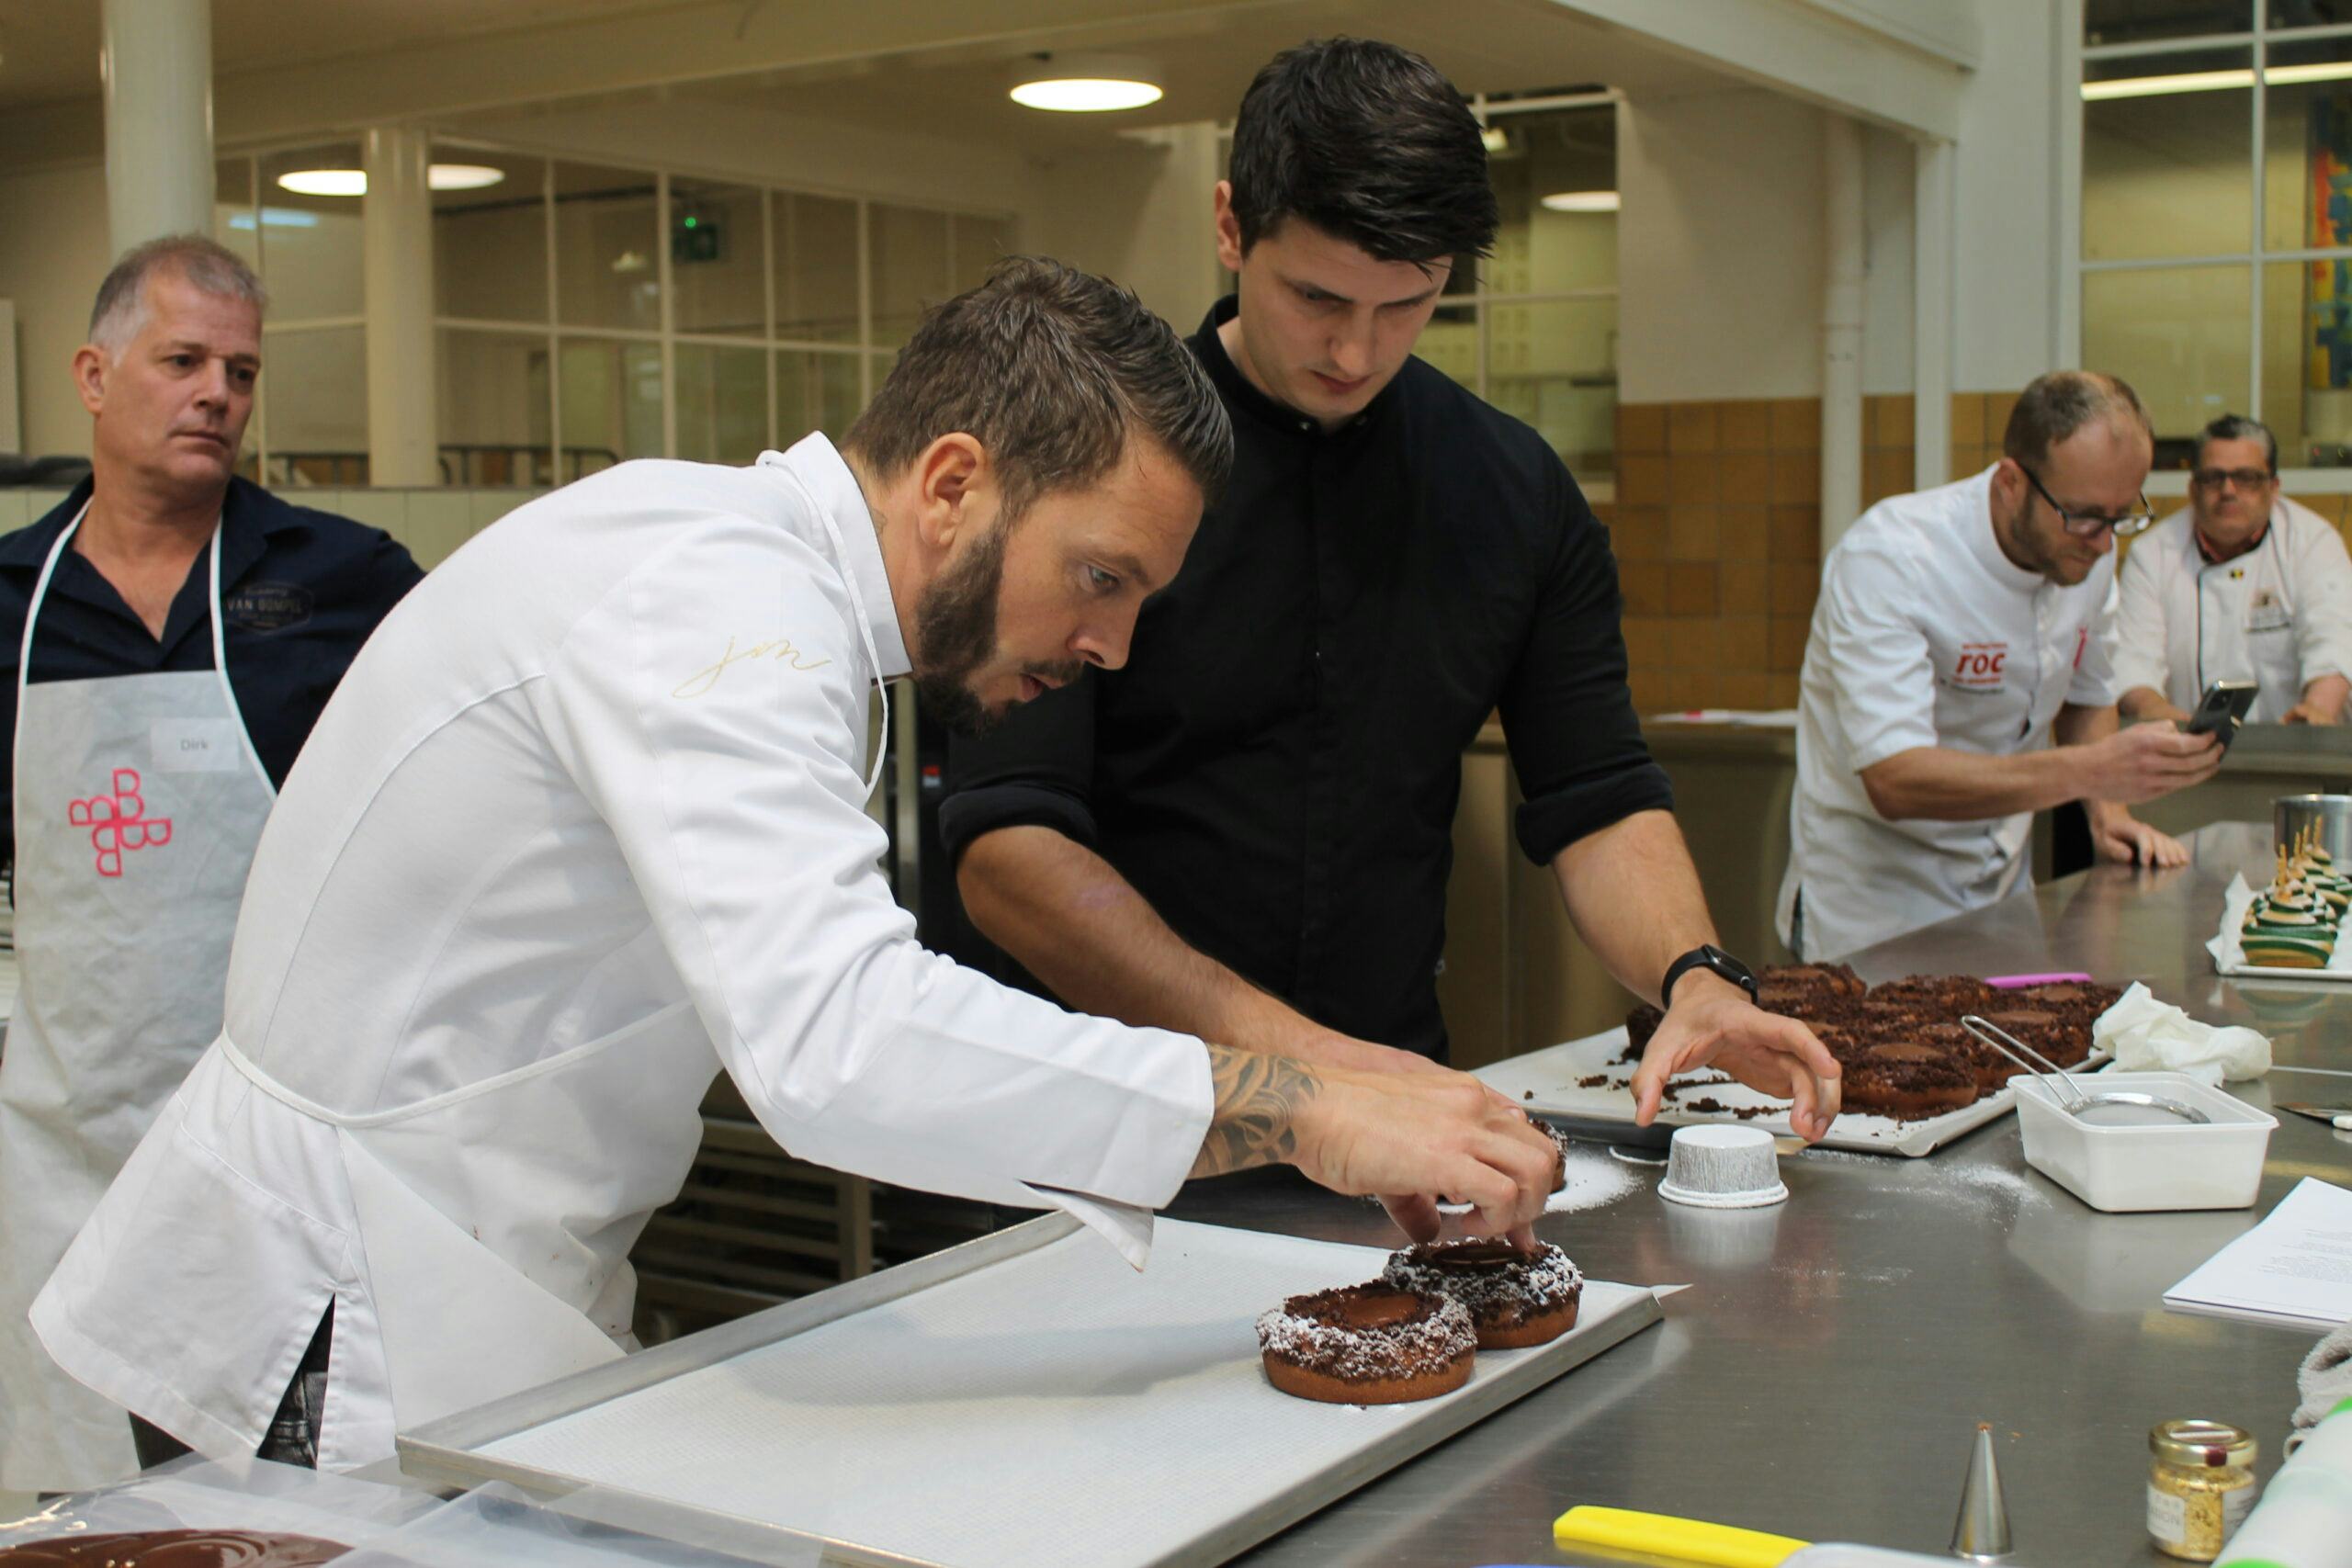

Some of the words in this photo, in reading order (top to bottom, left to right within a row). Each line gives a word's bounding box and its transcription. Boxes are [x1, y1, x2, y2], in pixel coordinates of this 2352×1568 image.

[226, 598, 253, 612] VAN
[1954, 652, 2006, 675] roc
[180, 738, 209, 751] Dirk
